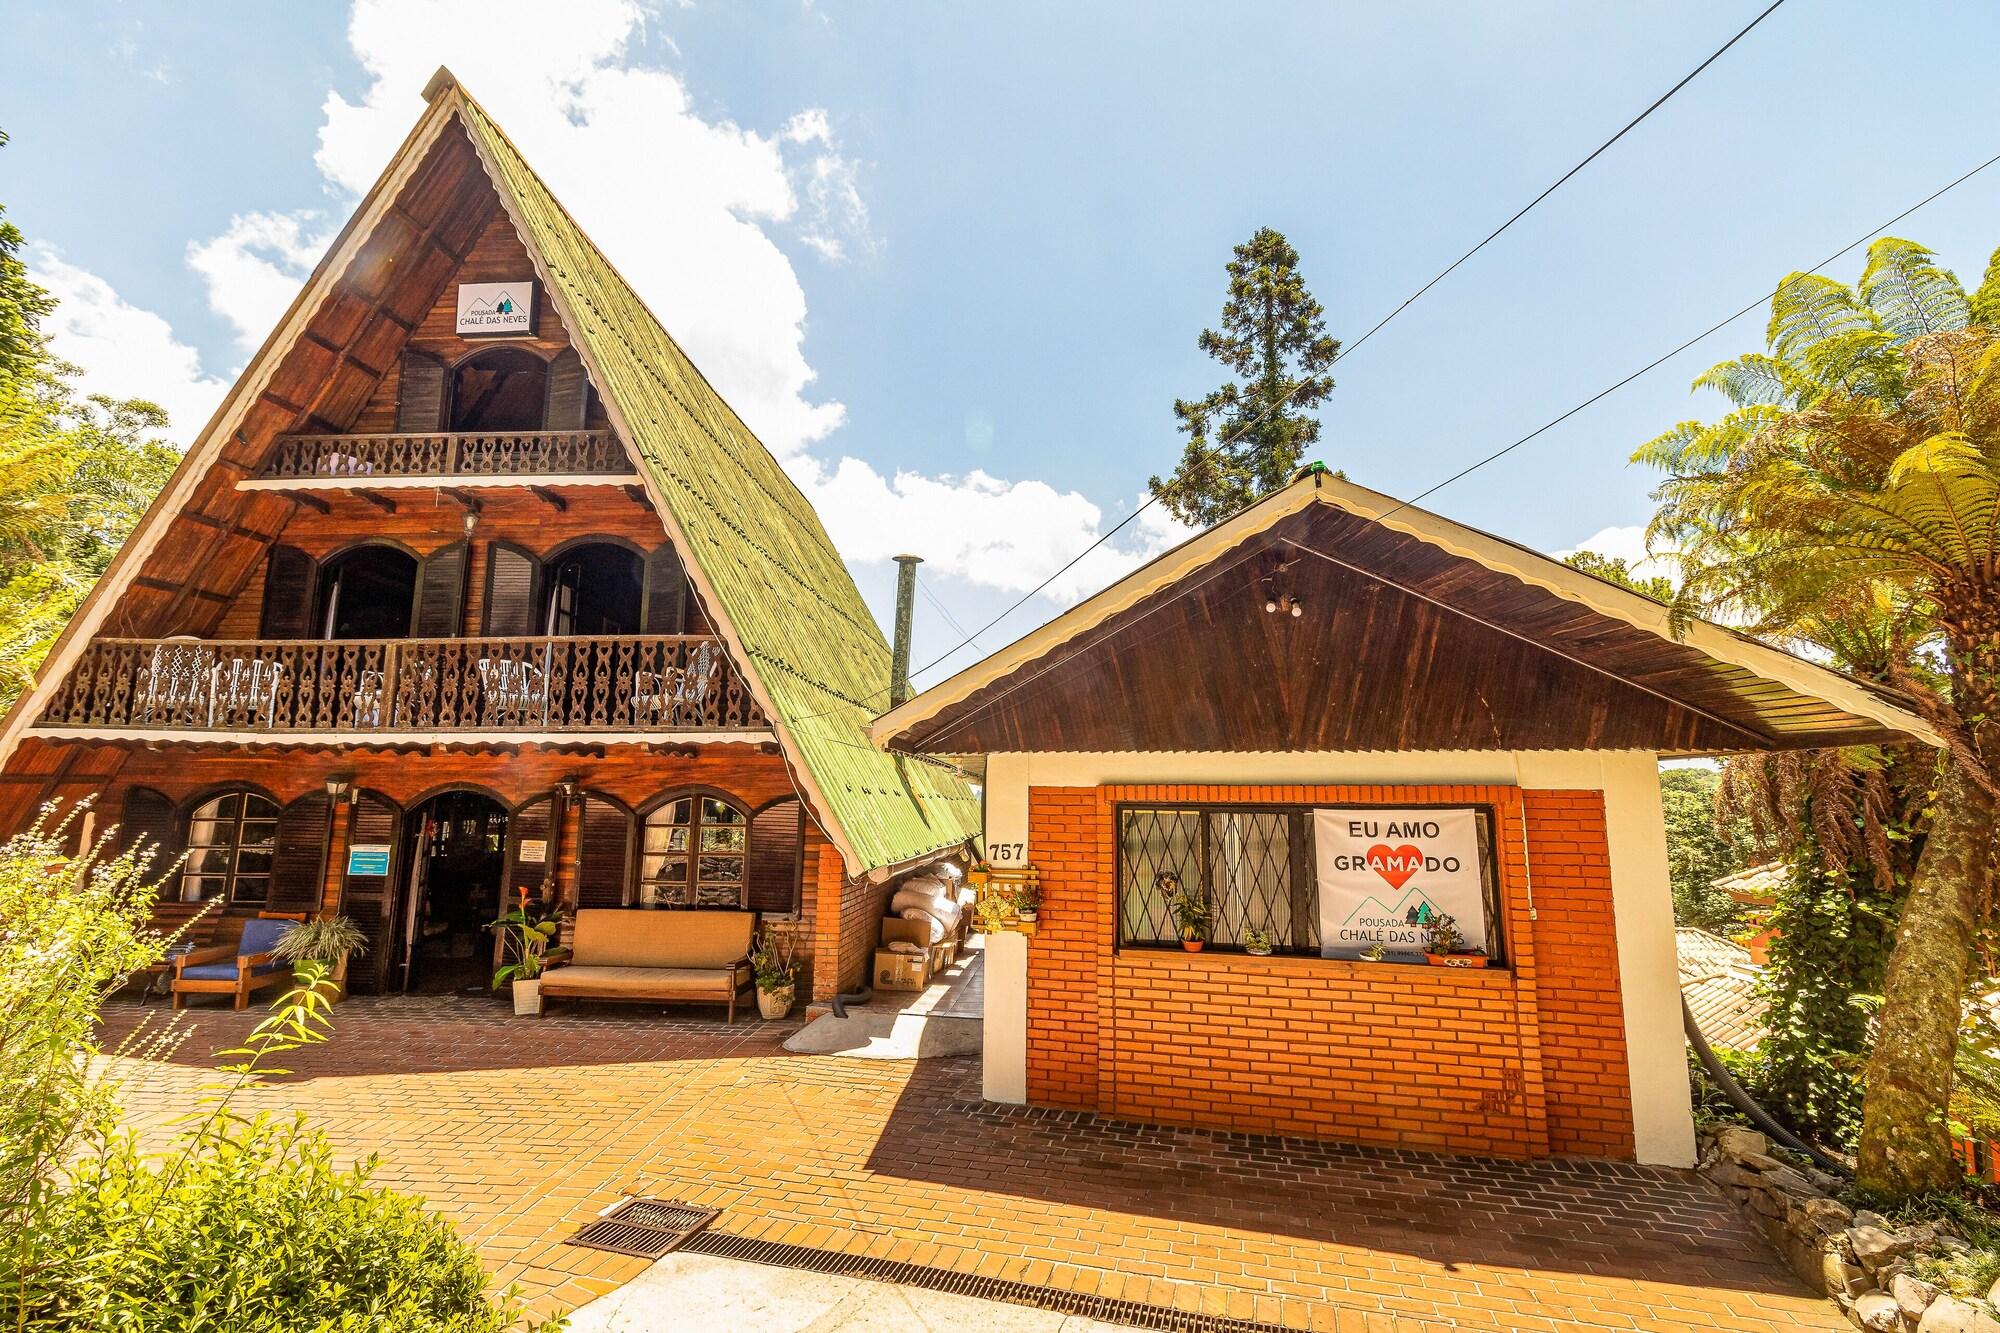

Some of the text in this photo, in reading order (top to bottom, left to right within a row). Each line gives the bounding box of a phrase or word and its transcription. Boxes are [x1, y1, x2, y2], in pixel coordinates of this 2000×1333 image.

[460, 315, 527, 325] CHALÉ DAS NEVES
[1348, 821, 1440, 838] EU AMO
[989, 844, 1024, 861] 757
[1334, 855, 1460, 873] GRAMADO
[1359, 918, 1405, 928] POUSADA
[1340, 928, 1384, 942] CHALÉ
[1389, 931, 1415, 943] DAS
